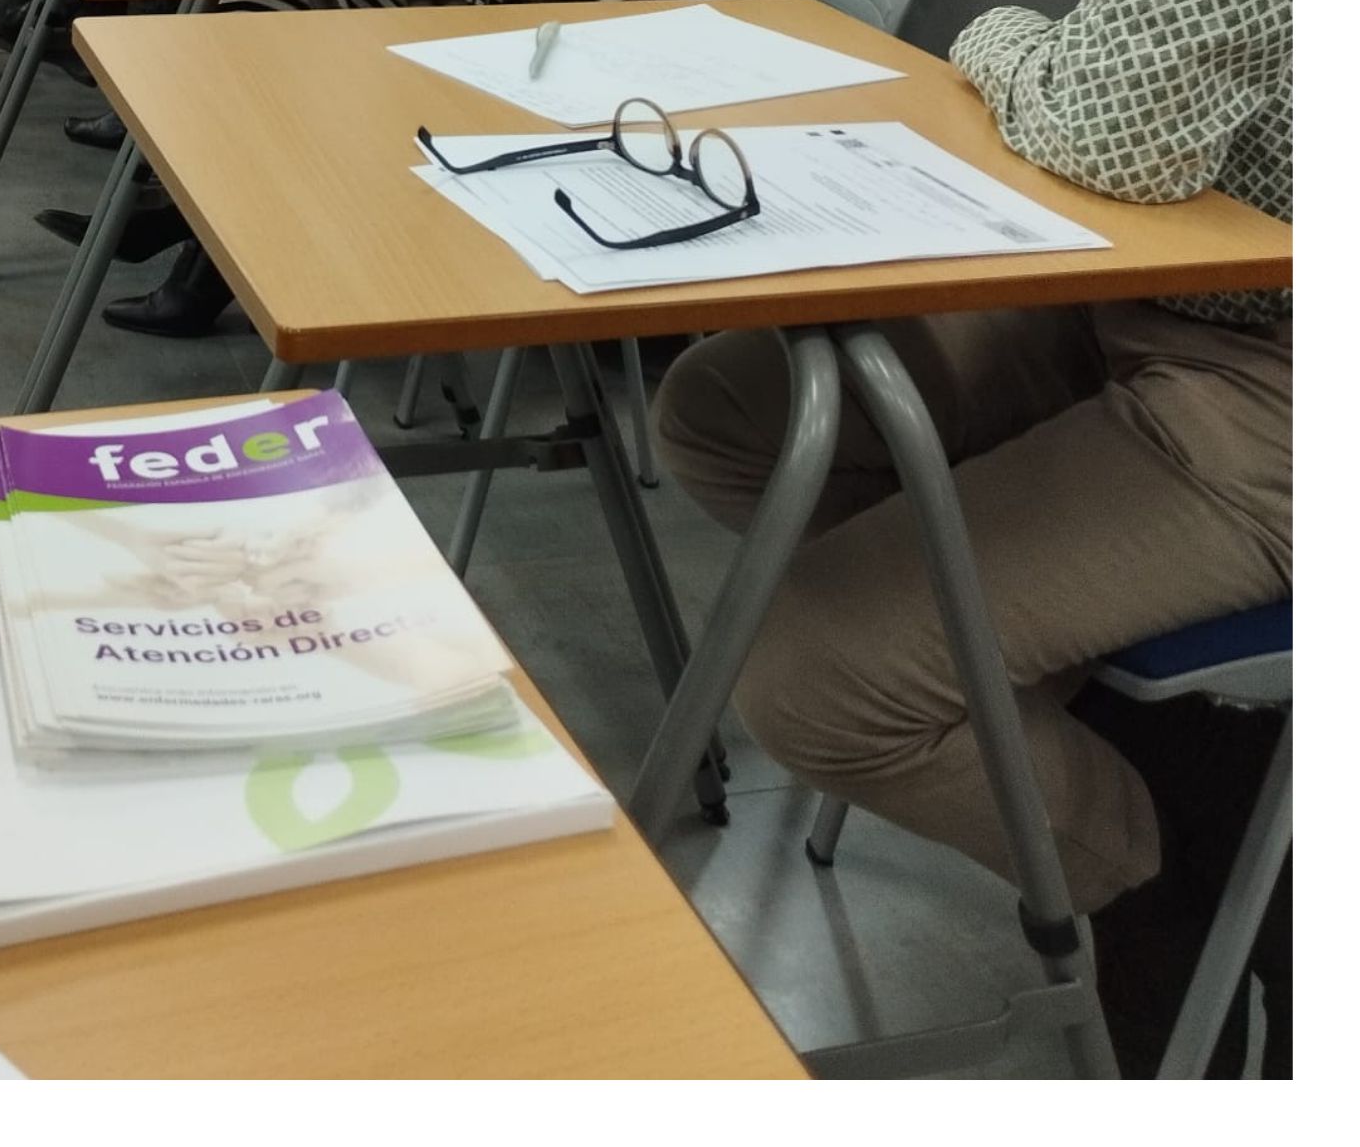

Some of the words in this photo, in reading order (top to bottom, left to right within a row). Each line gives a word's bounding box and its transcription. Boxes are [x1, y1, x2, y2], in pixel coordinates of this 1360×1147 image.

[88, 415, 329, 481] feder
[74, 616, 264, 637] Servicios
[274, 609, 324, 629] de
[95, 641, 281, 664] Atención
